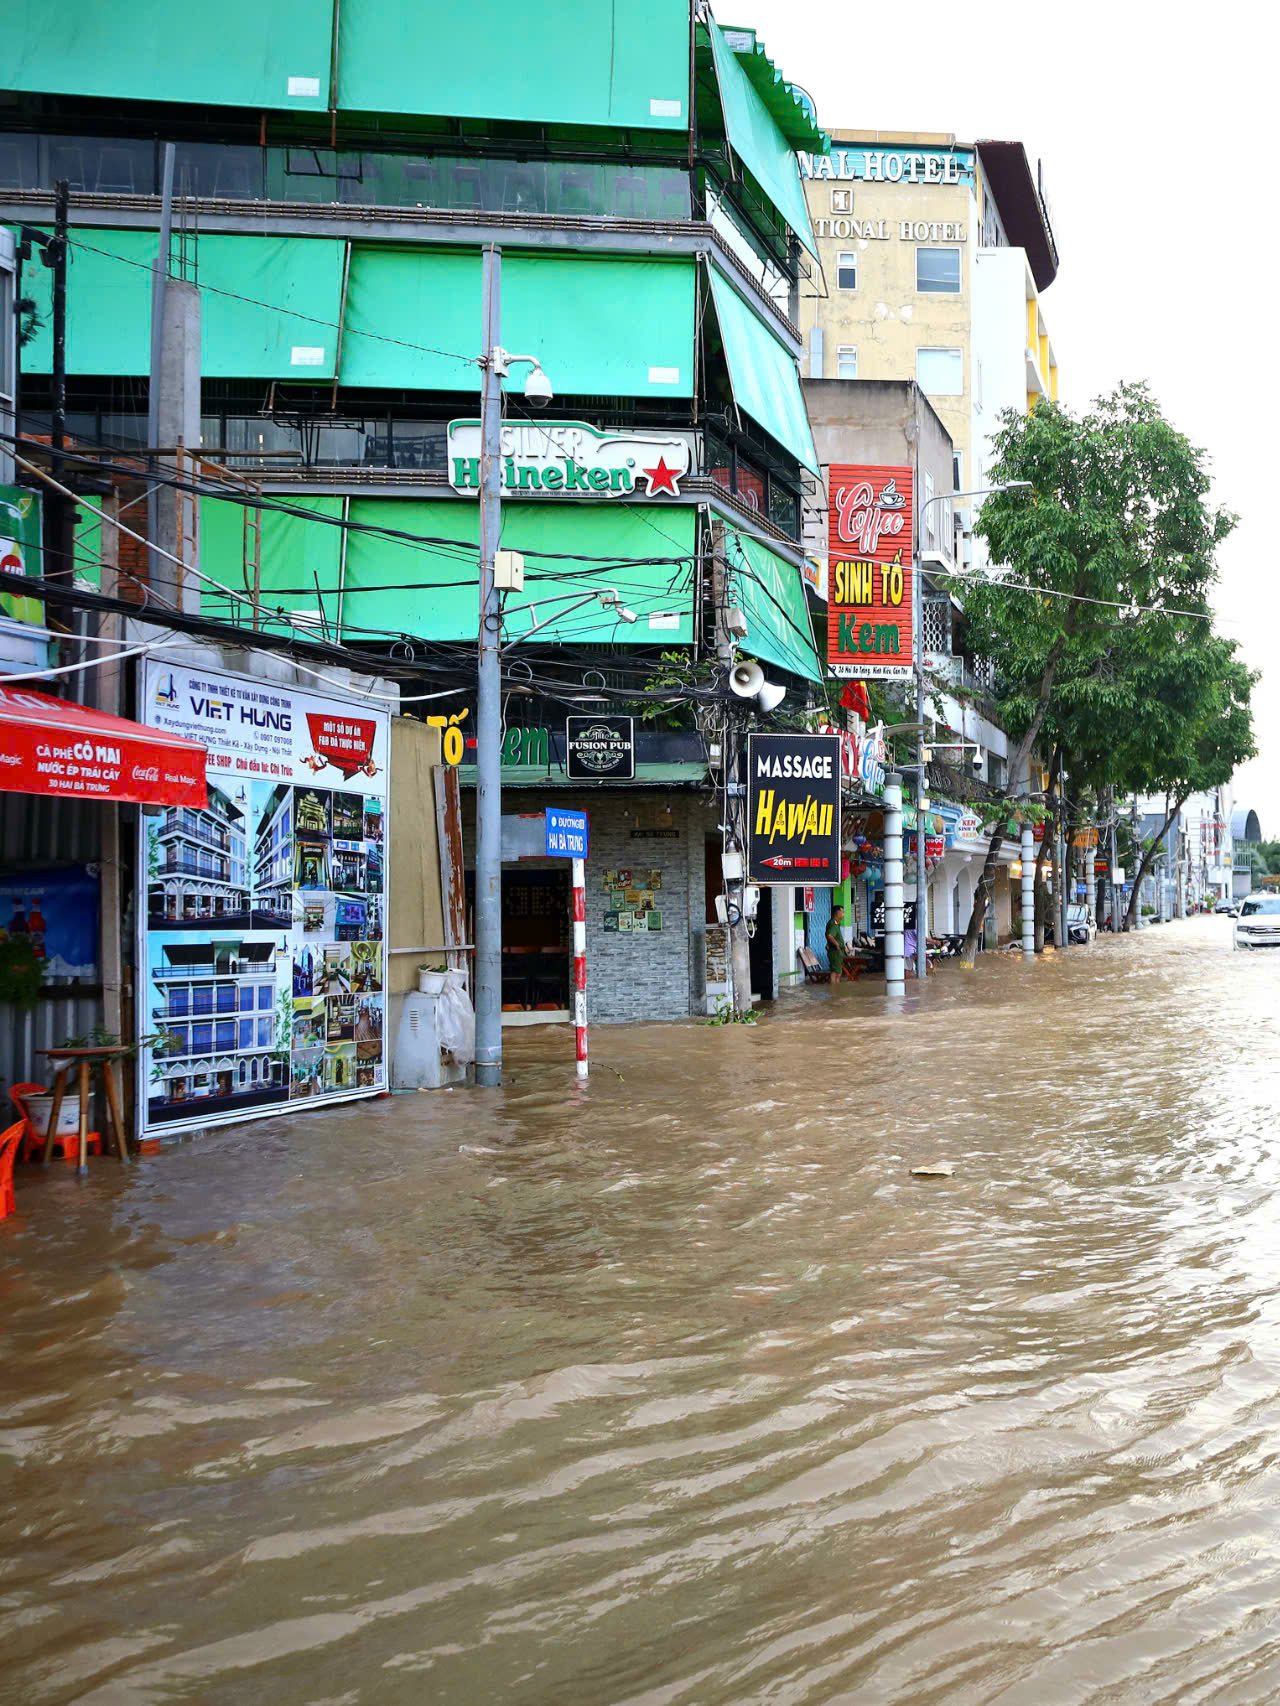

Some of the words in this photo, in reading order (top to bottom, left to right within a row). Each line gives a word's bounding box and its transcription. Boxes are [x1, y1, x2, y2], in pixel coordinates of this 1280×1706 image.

[862, 152, 961, 184] HOTEL
[899, 221, 967, 242] HOTEL
[500, 426, 584, 458] SILVER
[452, 456, 636, 491] Hineken
[835, 481, 905, 554] Coffee
[834, 561, 873, 605] SINH
[880, 547, 904, 606] TỐ
[838, 612, 900, 655] Kem
[36, 744, 52, 759] CÀ
[53, 745, 73, 761] PHÊ
[73, 740, 93, 761] CÔ
[95, 745, 121, 765] MAI
[500, 727, 549, 766] em
[569, 741, 607, 750] FUSION
[610, 741, 632, 750] PUB
[37, 761, 66, 776] NƯỚC
[66, 762, 78, 776] ÉP
[80, 764, 102, 780] TRÁI
[102, 766, 121, 781] CÂY
[216, 754, 232, 768] SHOP
[757, 754, 833, 779] MASSAGE
[59, 780, 73, 790] HAI
[164, 772, 179, 783] Real
[179, 774, 198, 786] Magic
[755, 789, 834, 845] HAWAII
[549, 832, 559, 850] HAI
[559, 830, 567, 851] BÀ
[773, 858, 792, 866] 20m
